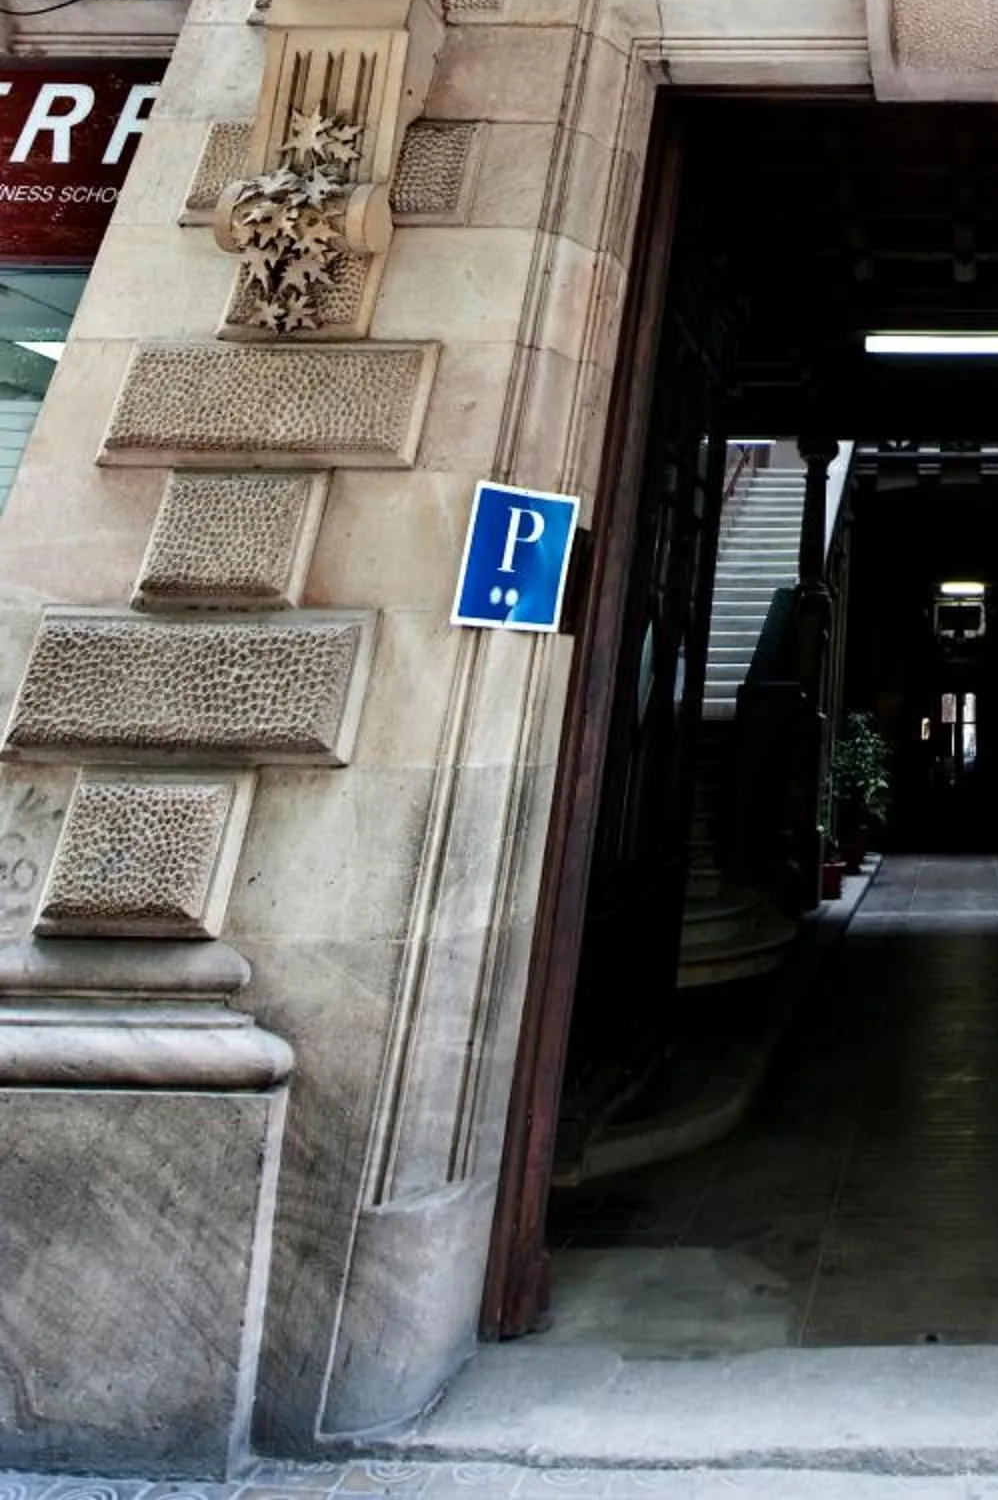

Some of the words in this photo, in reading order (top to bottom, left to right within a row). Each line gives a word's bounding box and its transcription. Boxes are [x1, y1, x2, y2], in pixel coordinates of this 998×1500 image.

[0, 82, 161, 165] RP
[58, 185, 120, 203] SCHO
[496, 506, 545, 573] P
